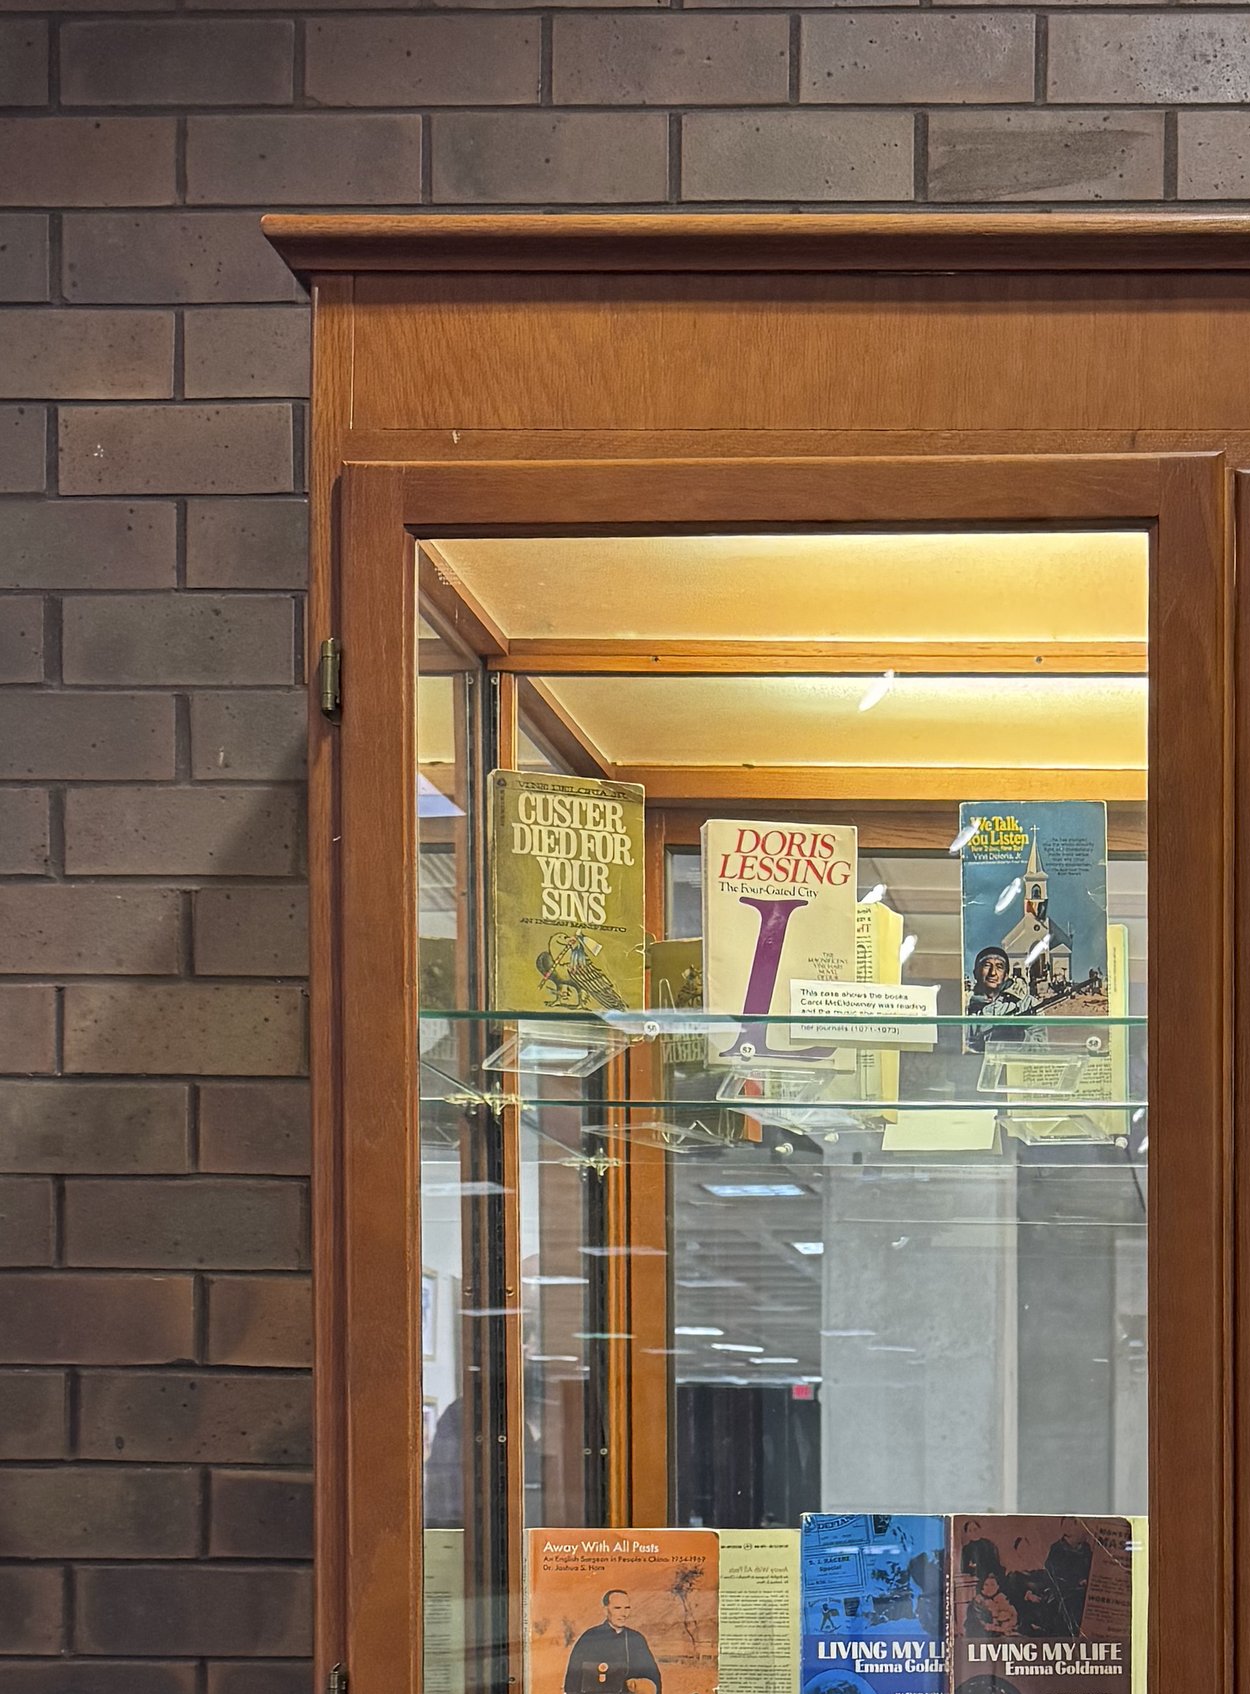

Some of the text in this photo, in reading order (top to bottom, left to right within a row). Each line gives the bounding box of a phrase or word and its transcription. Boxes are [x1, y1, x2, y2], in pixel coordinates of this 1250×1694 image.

[518, 792, 626, 834] CUSTER
[970, 816, 1024, 833] We Talk,
[512, 823, 634, 866] DIED FOR
[734, 828, 836, 859] DORIS
[990, 831, 1030, 845] Listen
[536, 856, 612, 894] YOUR
[718, 854, 850, 886] LESSING
[719, 882, 818, 898] The Four-Gated City
[542, 889, 606, 926] SINS
[543, 1542, 578, 1554] Away
[582, 1542, 610, 1552] With
[613, 1541, 629, 1552] All
[818, 1642, 944, 1659] LIVING MY LI
[968, 1642, 1122, 1662] LIVING MY LIFE
[855, 1659, 902, 1673] Emma
[1005, 1661, 1122, 1676] Emma Goldman
